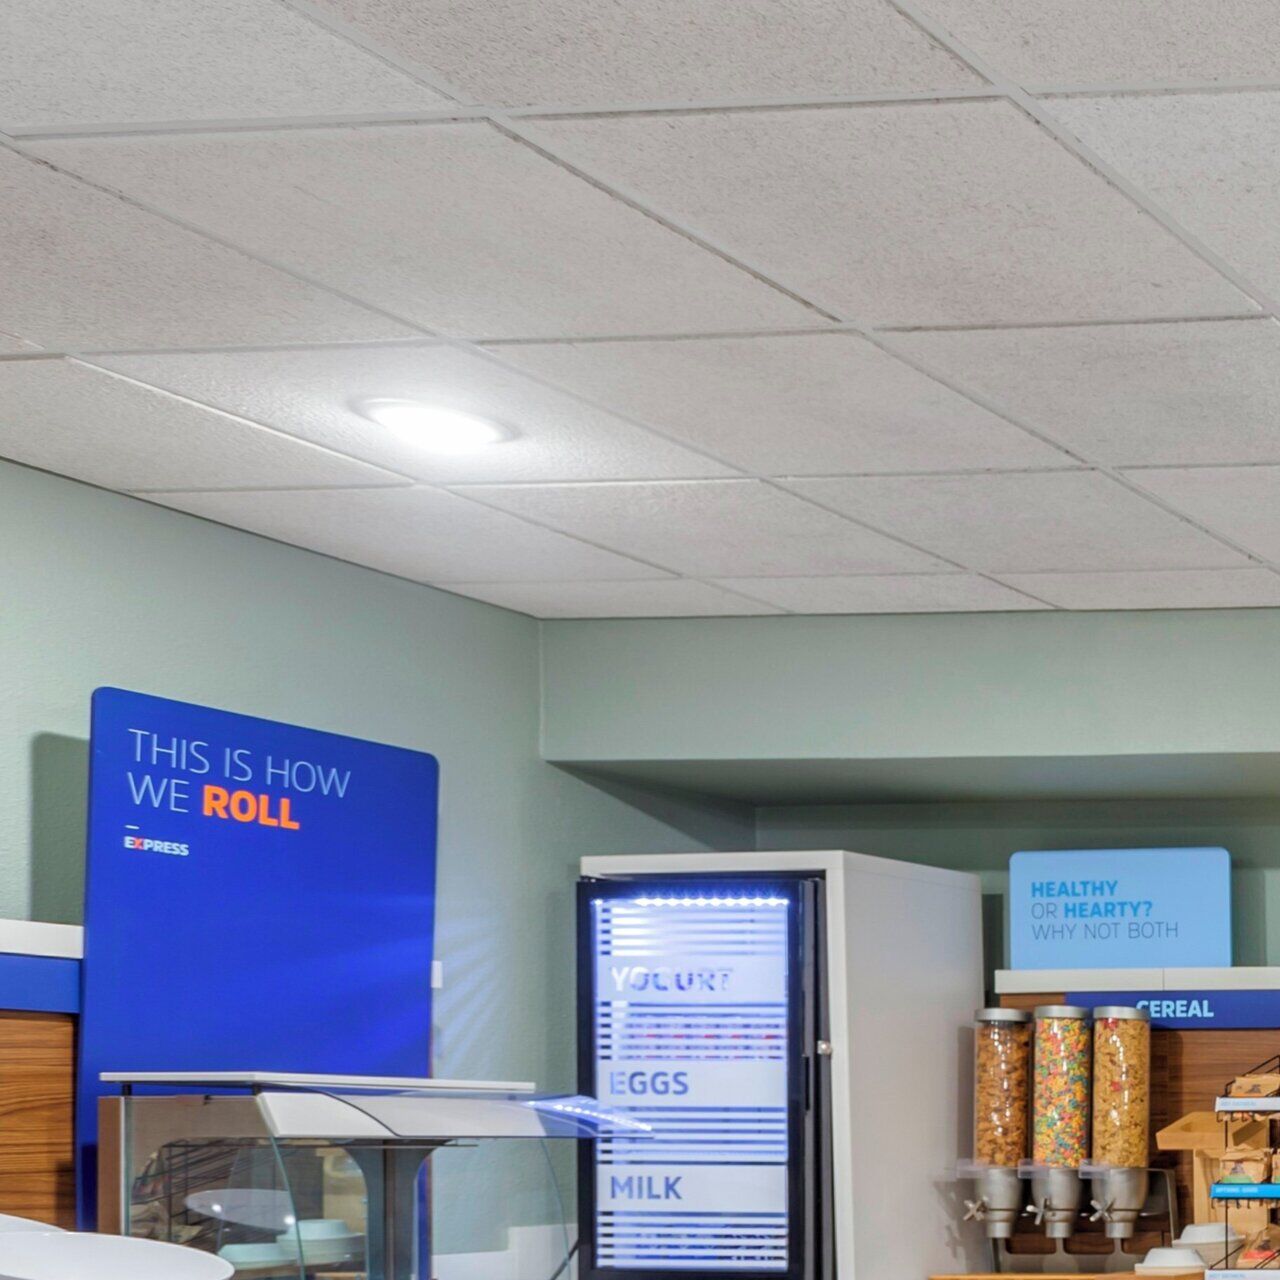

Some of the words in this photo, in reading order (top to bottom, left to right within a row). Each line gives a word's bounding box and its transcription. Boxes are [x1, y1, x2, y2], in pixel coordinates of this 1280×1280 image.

[127, 729, 210, 774] THIS
[224, 747, 253, 781] IS
[266, 755, 351, 797] HOW
[127, 772, 190, 813] WE
[203, 784, 300, 830] ROLL
[124, 835, 189, 857] EXPRESS
[1031, 880, 1118, 898] HEALTHY
[1031, 902, 1058, 920] OR
[1064, 900, 1153, 919] HEARTY?
[1031, 923, 1077, 940] WHY
[1084, 922, 1121, 940] NOT
[1128, 921, 1179, 940] BOTH
[609, 1071, 689, 1096] EGGS
[610, 1176, 684, 1200] MILK
